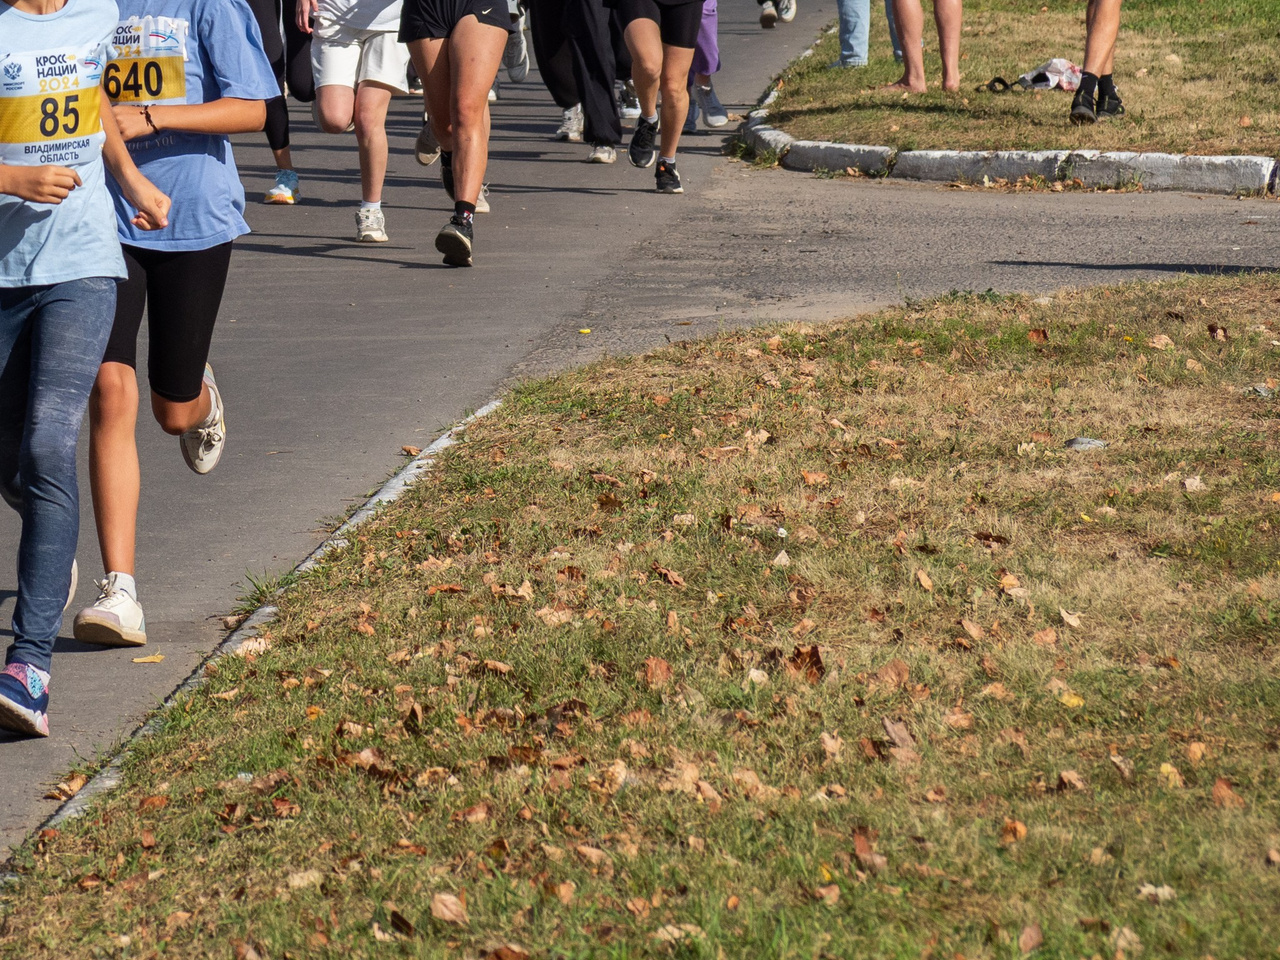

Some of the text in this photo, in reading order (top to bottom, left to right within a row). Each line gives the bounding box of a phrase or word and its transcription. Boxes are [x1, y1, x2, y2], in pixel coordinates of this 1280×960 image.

[112, 34, 141, 45] АЦИИ
[36, 54, 66, 67] КРОСС
[37, 64, 77, 79] НАЦИИ
[39, 76, 80, 93] 2024
[103, 61, 163, 98] 640
[39, 94, 80, 137] 85
[24, 139, 90, 154] ВЛАДИМИРСКАЯ
[39, 152, 80, 163] ОБЛАСТЬ
